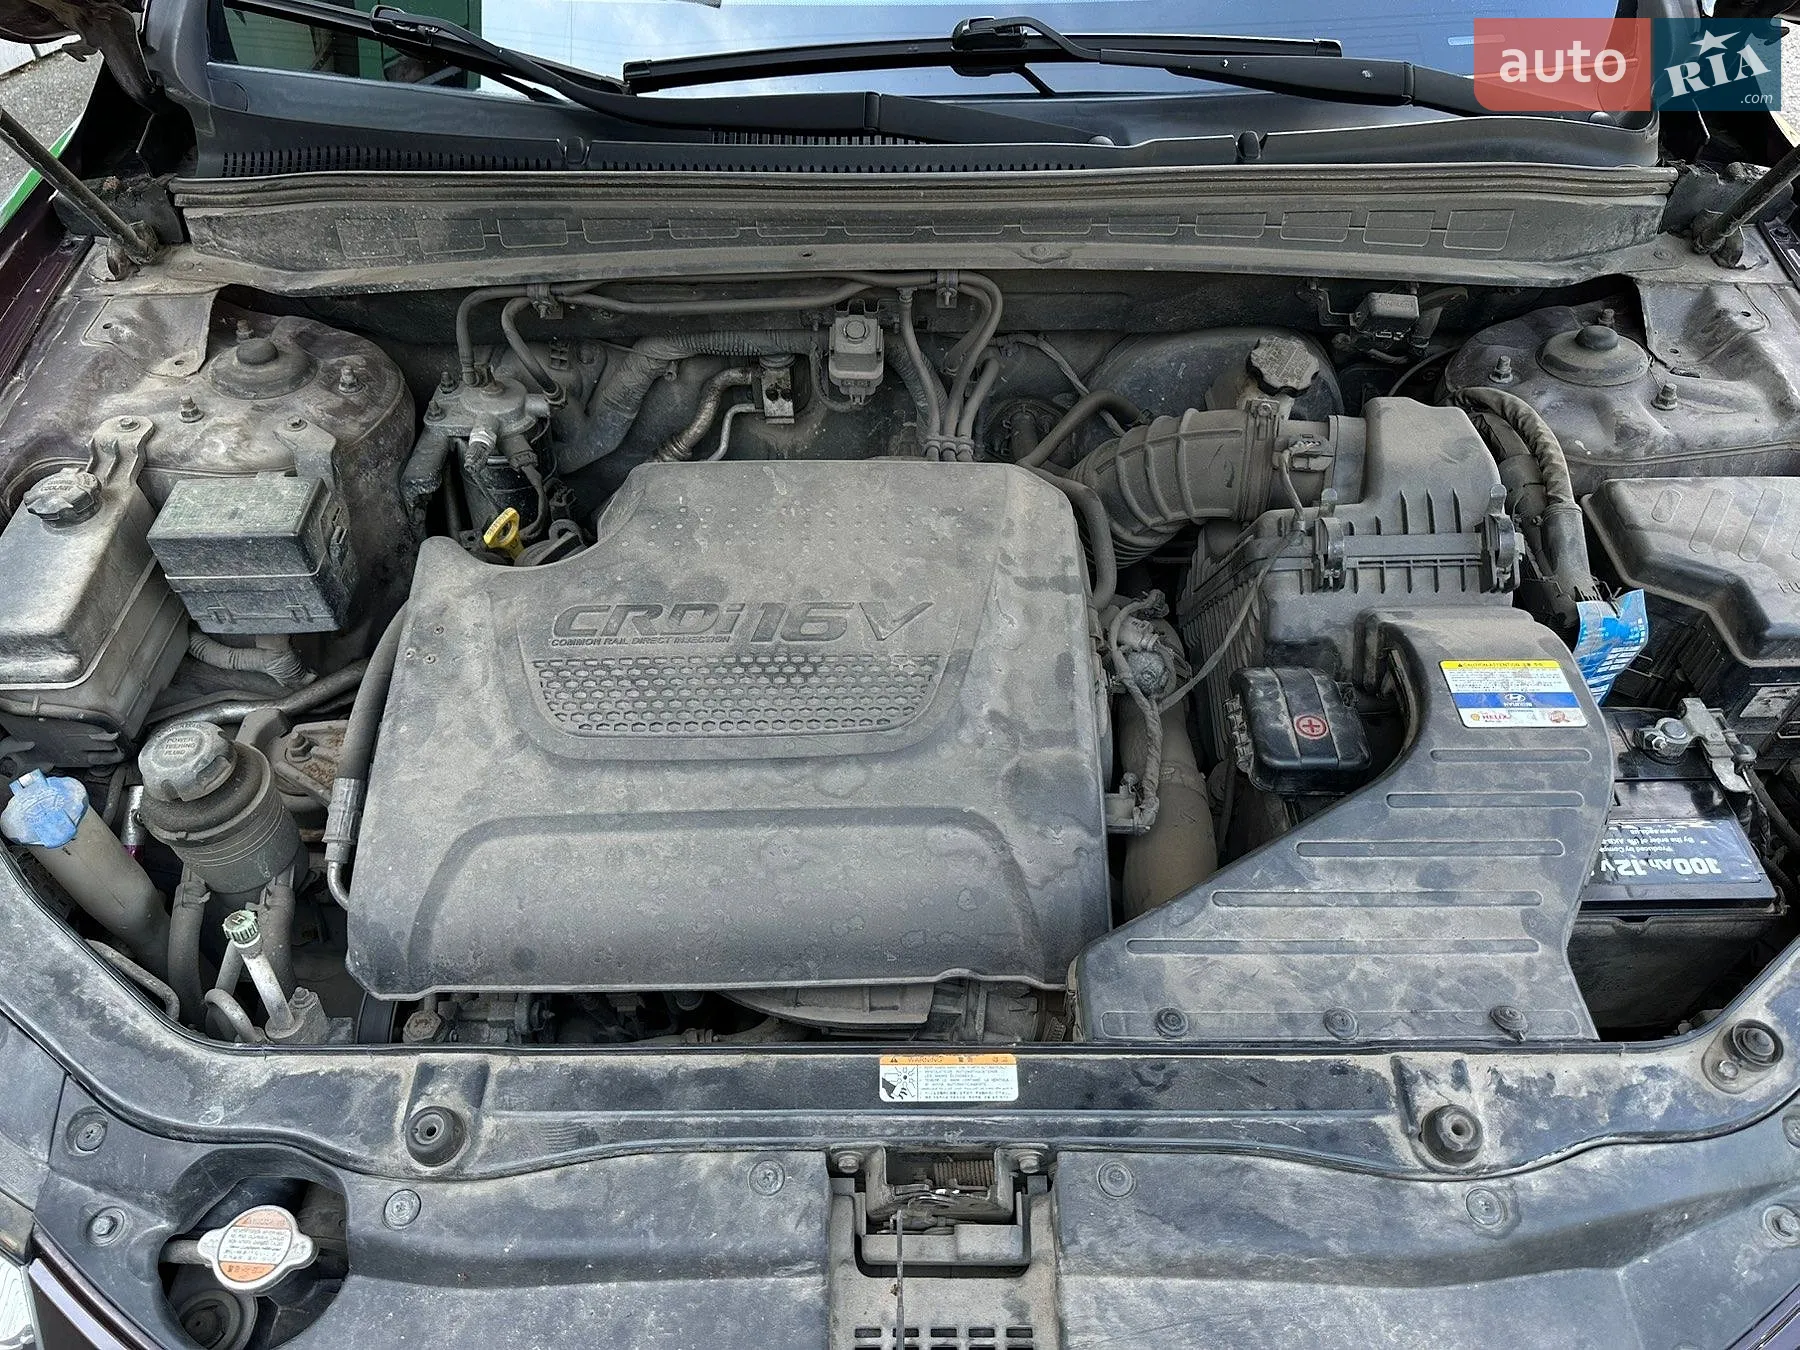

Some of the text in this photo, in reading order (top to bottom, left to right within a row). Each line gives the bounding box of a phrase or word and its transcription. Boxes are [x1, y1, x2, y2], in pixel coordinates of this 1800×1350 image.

[551, 635, 731, 647] COMMON RAIL DIRECT INJECTION
[1625, 843, 1635, 852] by
